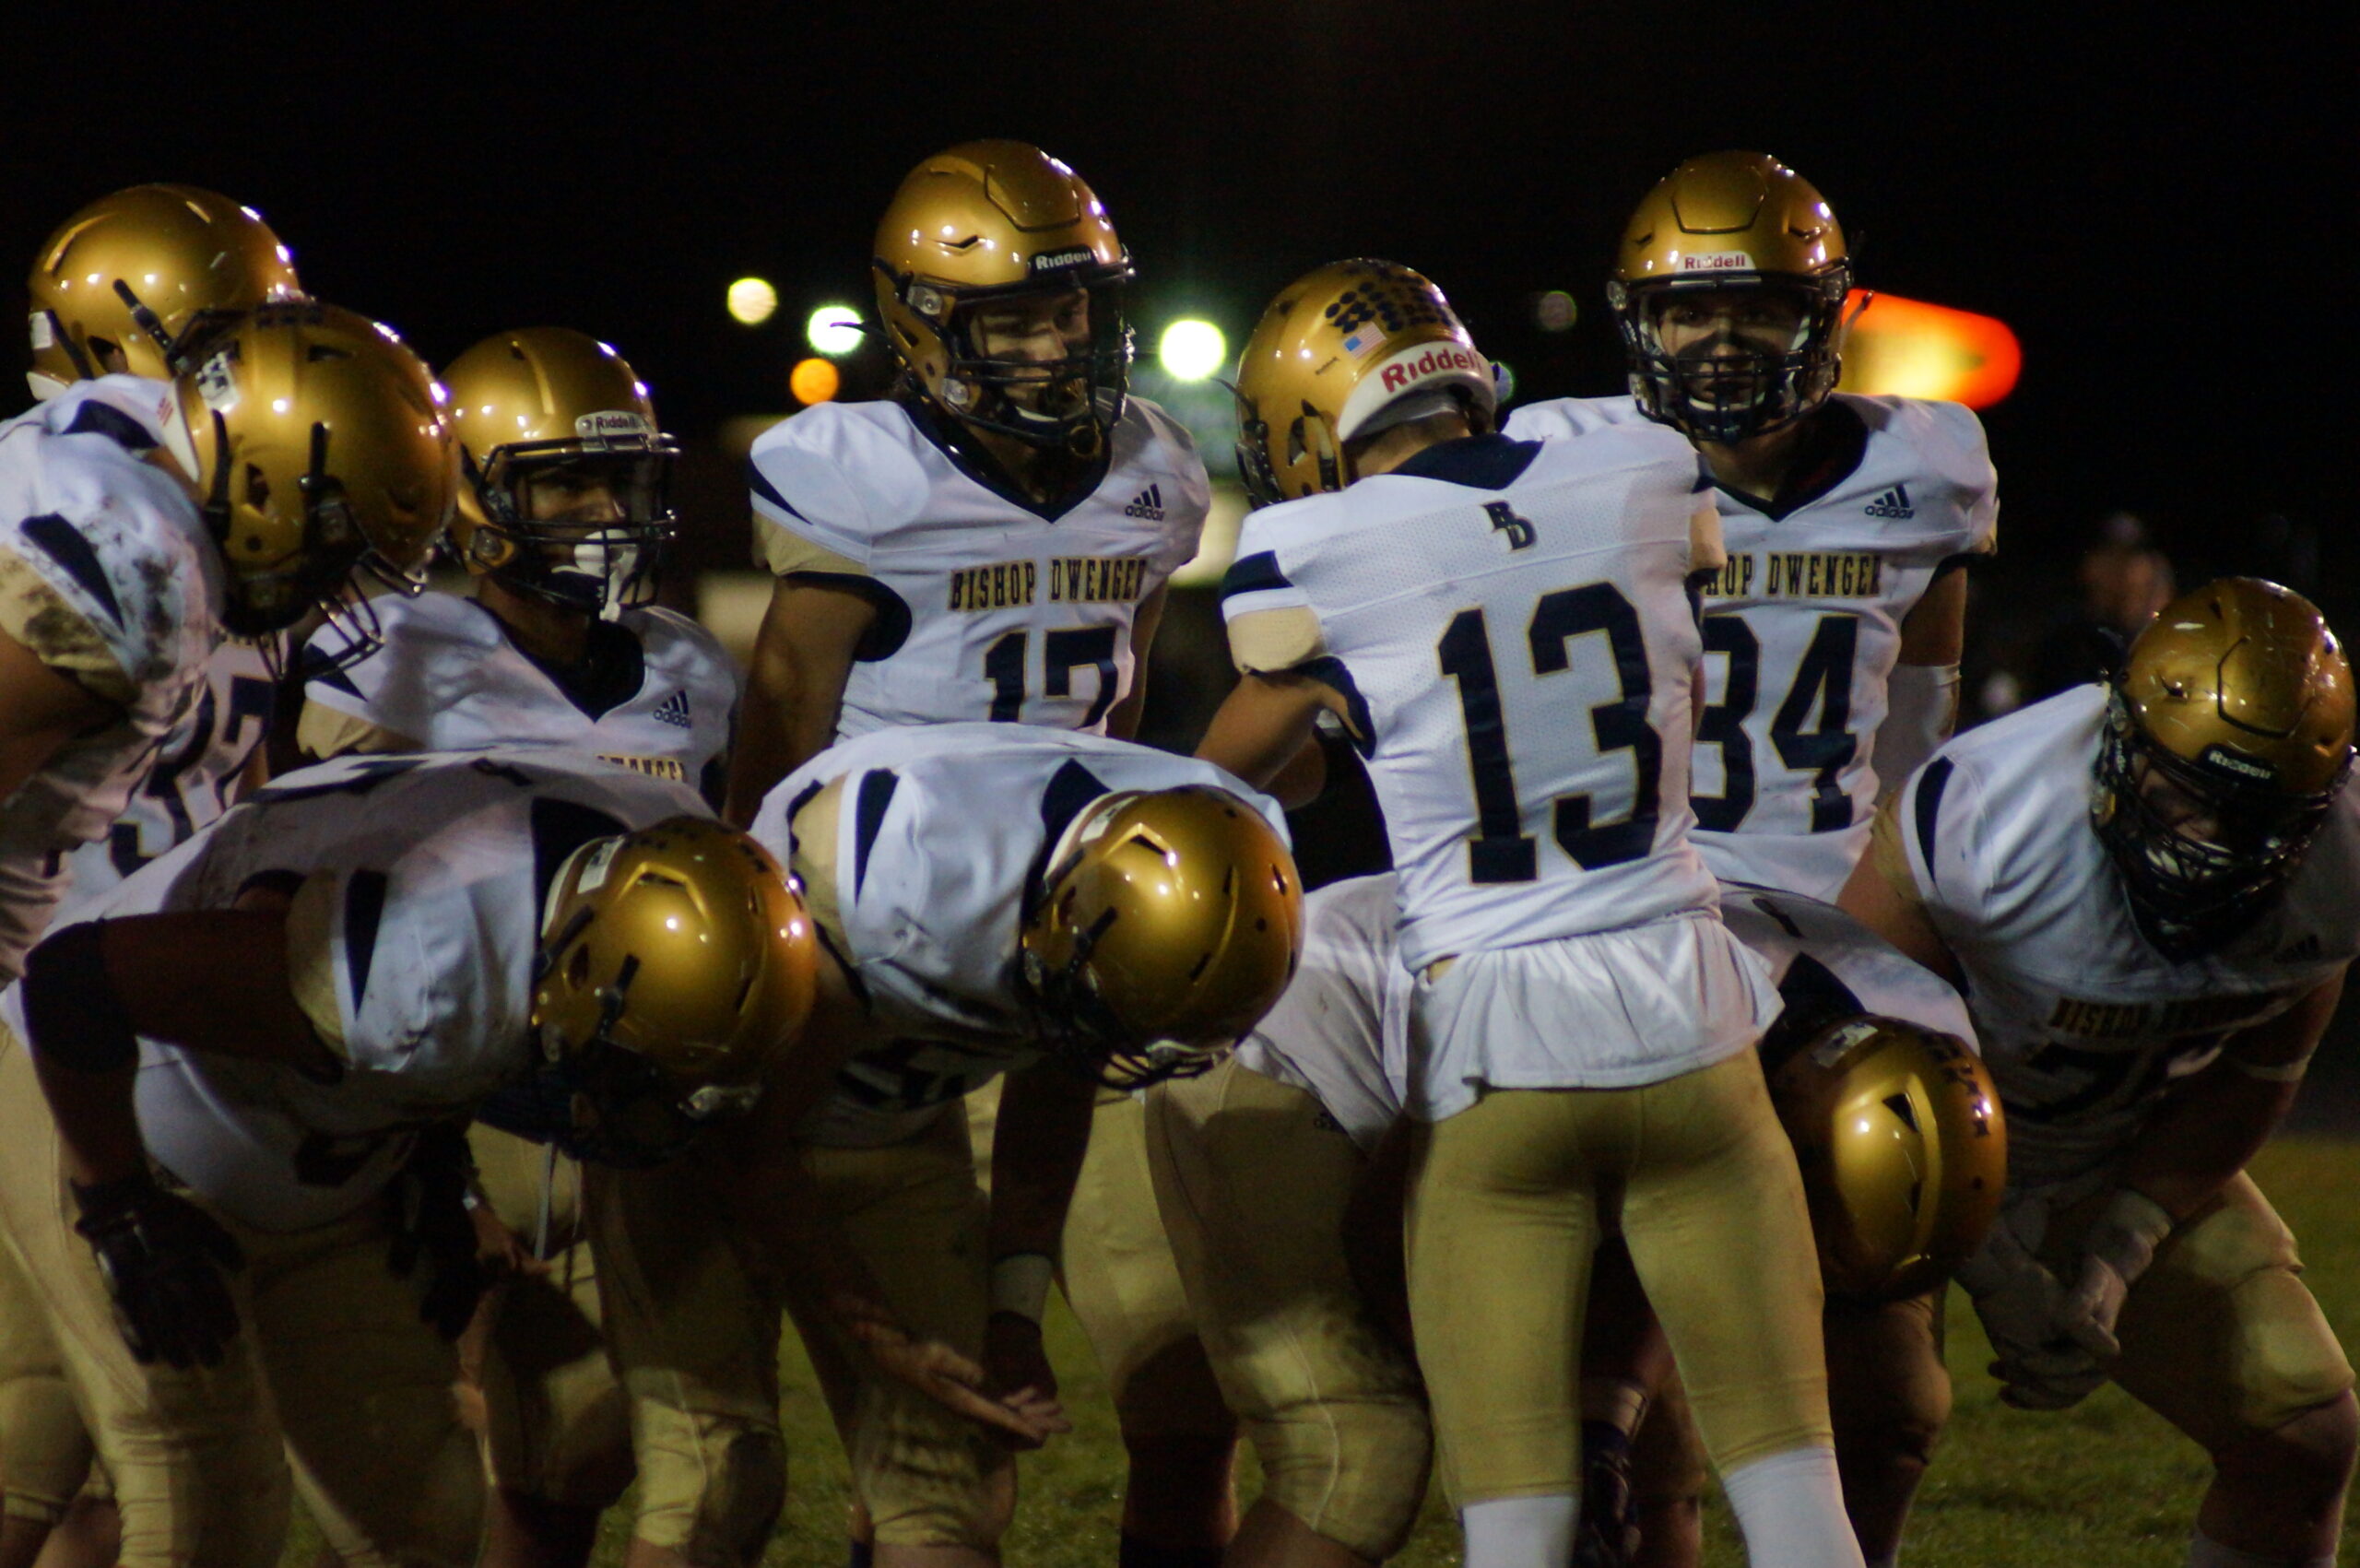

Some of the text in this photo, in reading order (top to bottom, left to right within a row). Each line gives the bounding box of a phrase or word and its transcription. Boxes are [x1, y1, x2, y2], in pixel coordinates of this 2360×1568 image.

[1683, 254, 1745, 269] Riddell
[1864, 504, 1915, 520] adidas
[949, 560, 1036, 611] BISHOP
[1767, 552, 1882, 597] DWENGER
[1436, 581, 1661, 885] 13
